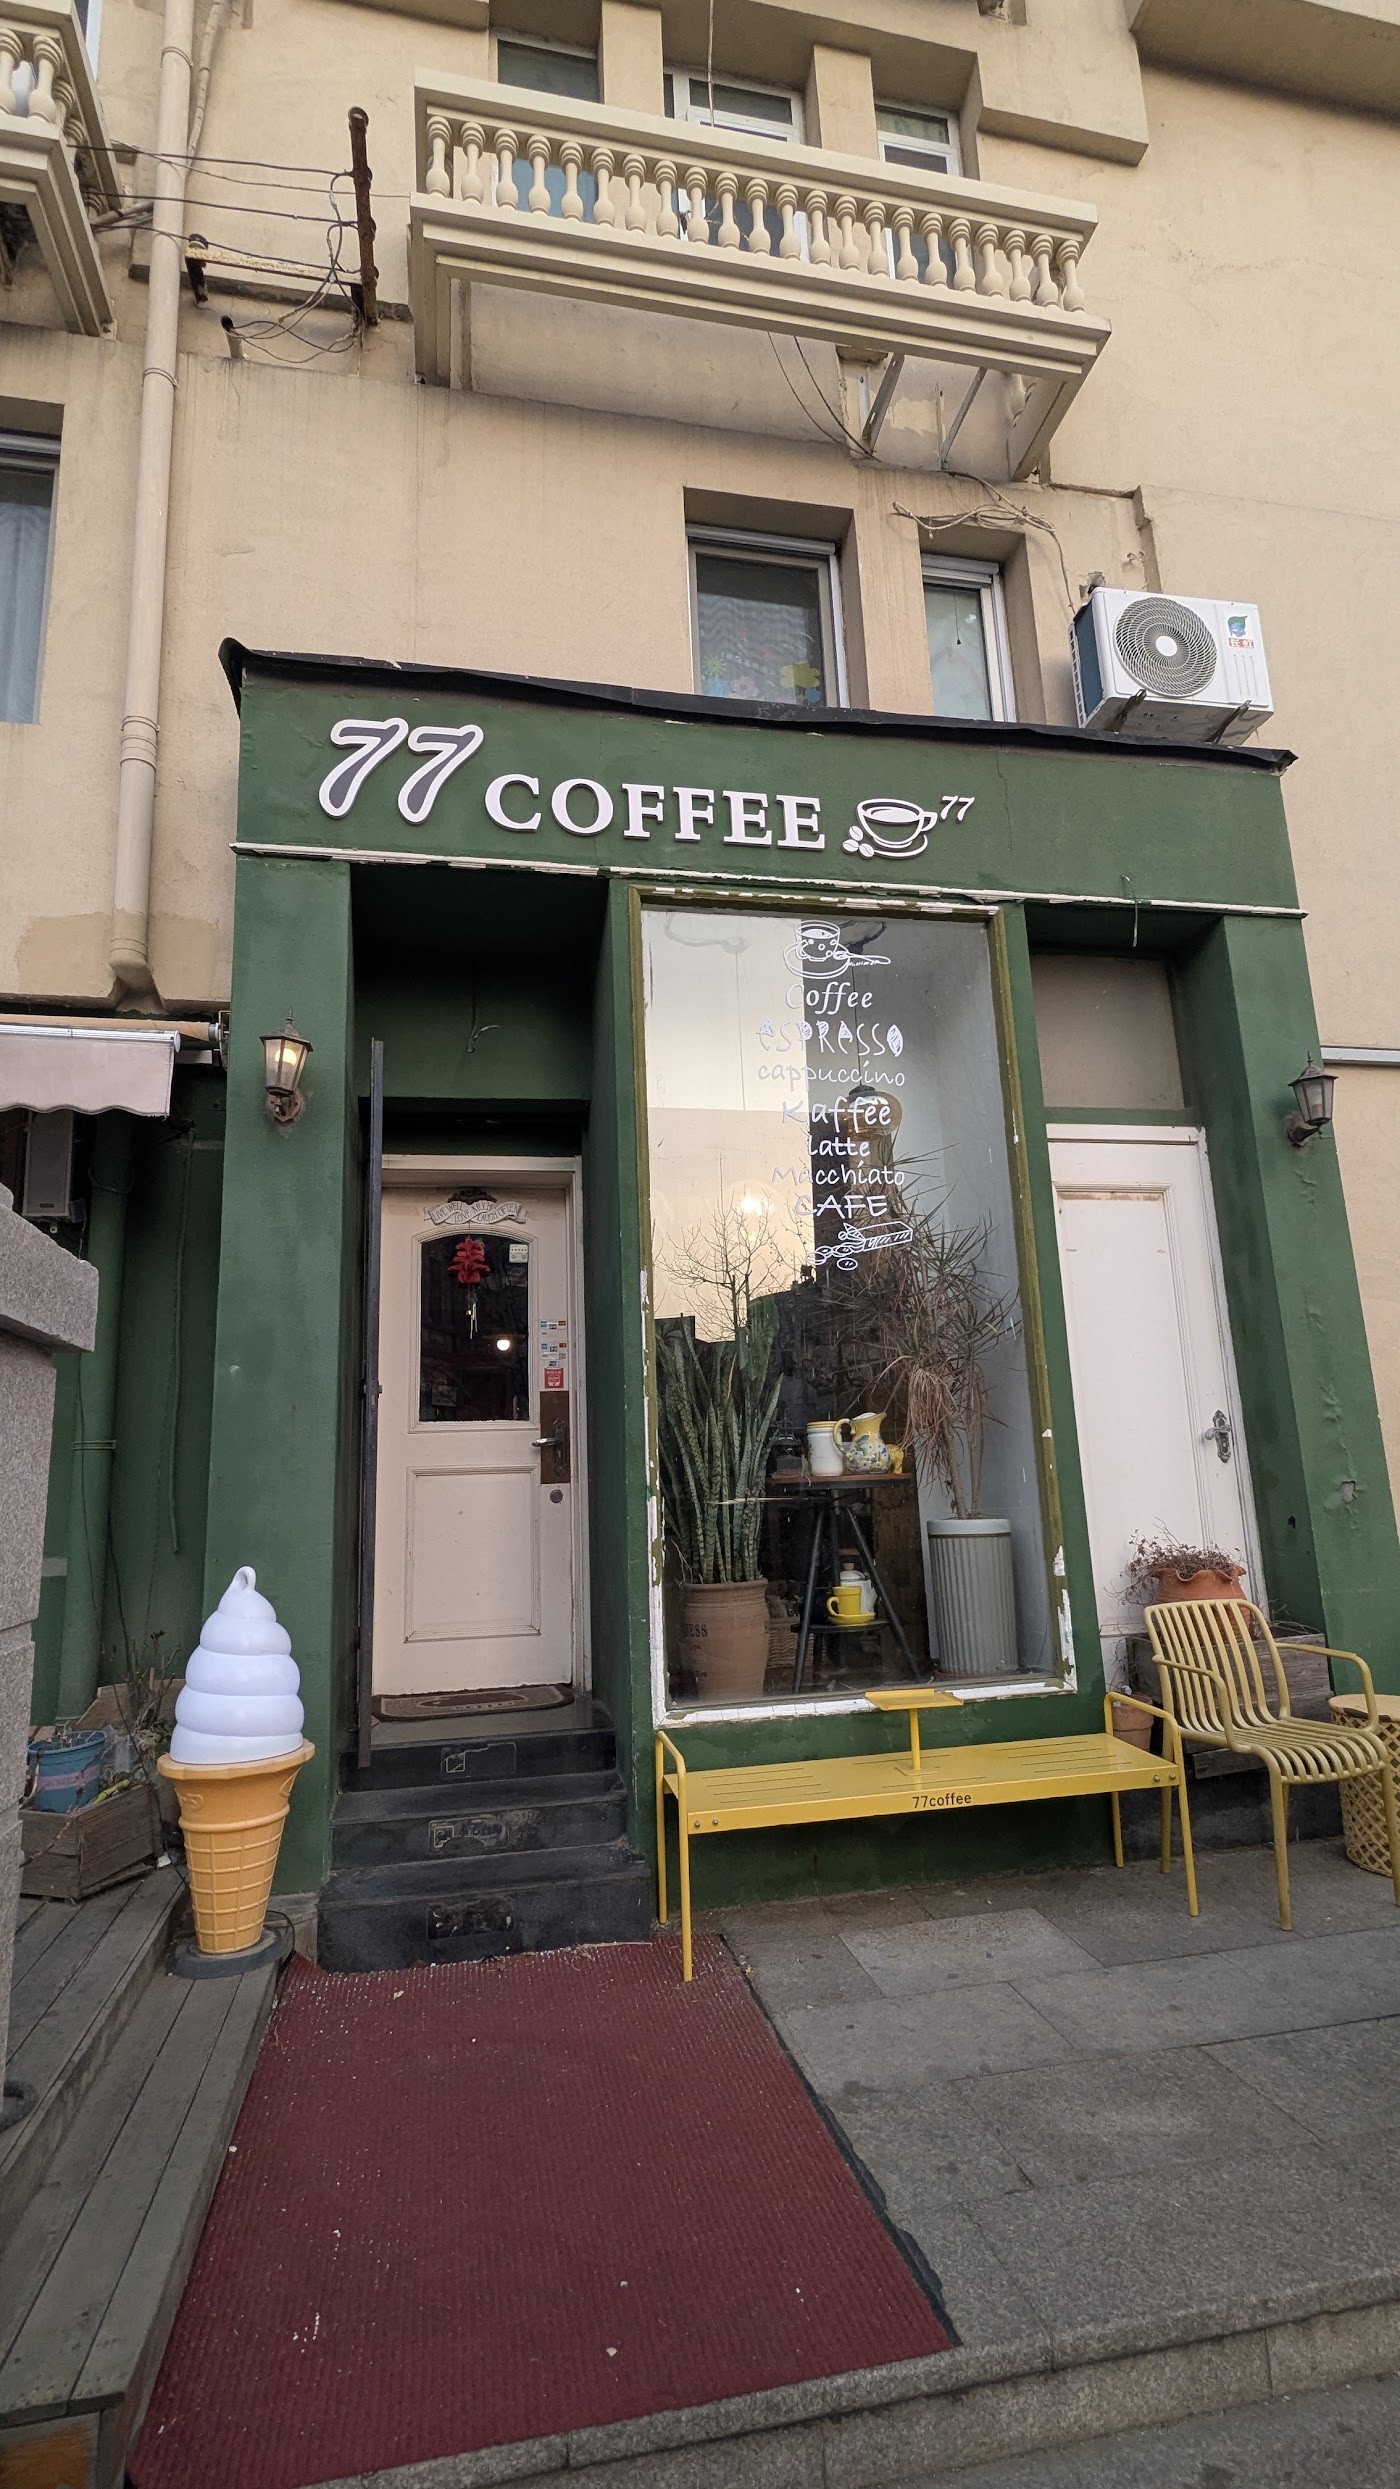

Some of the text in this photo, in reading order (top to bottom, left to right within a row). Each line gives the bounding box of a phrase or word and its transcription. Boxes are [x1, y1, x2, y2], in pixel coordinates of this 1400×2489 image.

[318, 717, 827, 852] 77 COFFEE
[939, 794, 975, 822] 77
[785, 981, 874, 1015] Coffee
[757, 1060, 906, 1093] cappuccino
[781, 1096, 892, 1134] Kaffee
[807, 1134, 871, 1157] latte
[771, 1160, 905, 1187] Macchiato
[432, 1202, 463, 1221] LIVE WELL
[454, 1209, 471, 1222] LOVE
[497, 1203, 518, 1214] OFTEN
[794, 1194, 888, 1220] CAFE
[912, 1792, 972, 1808] 77coffee
